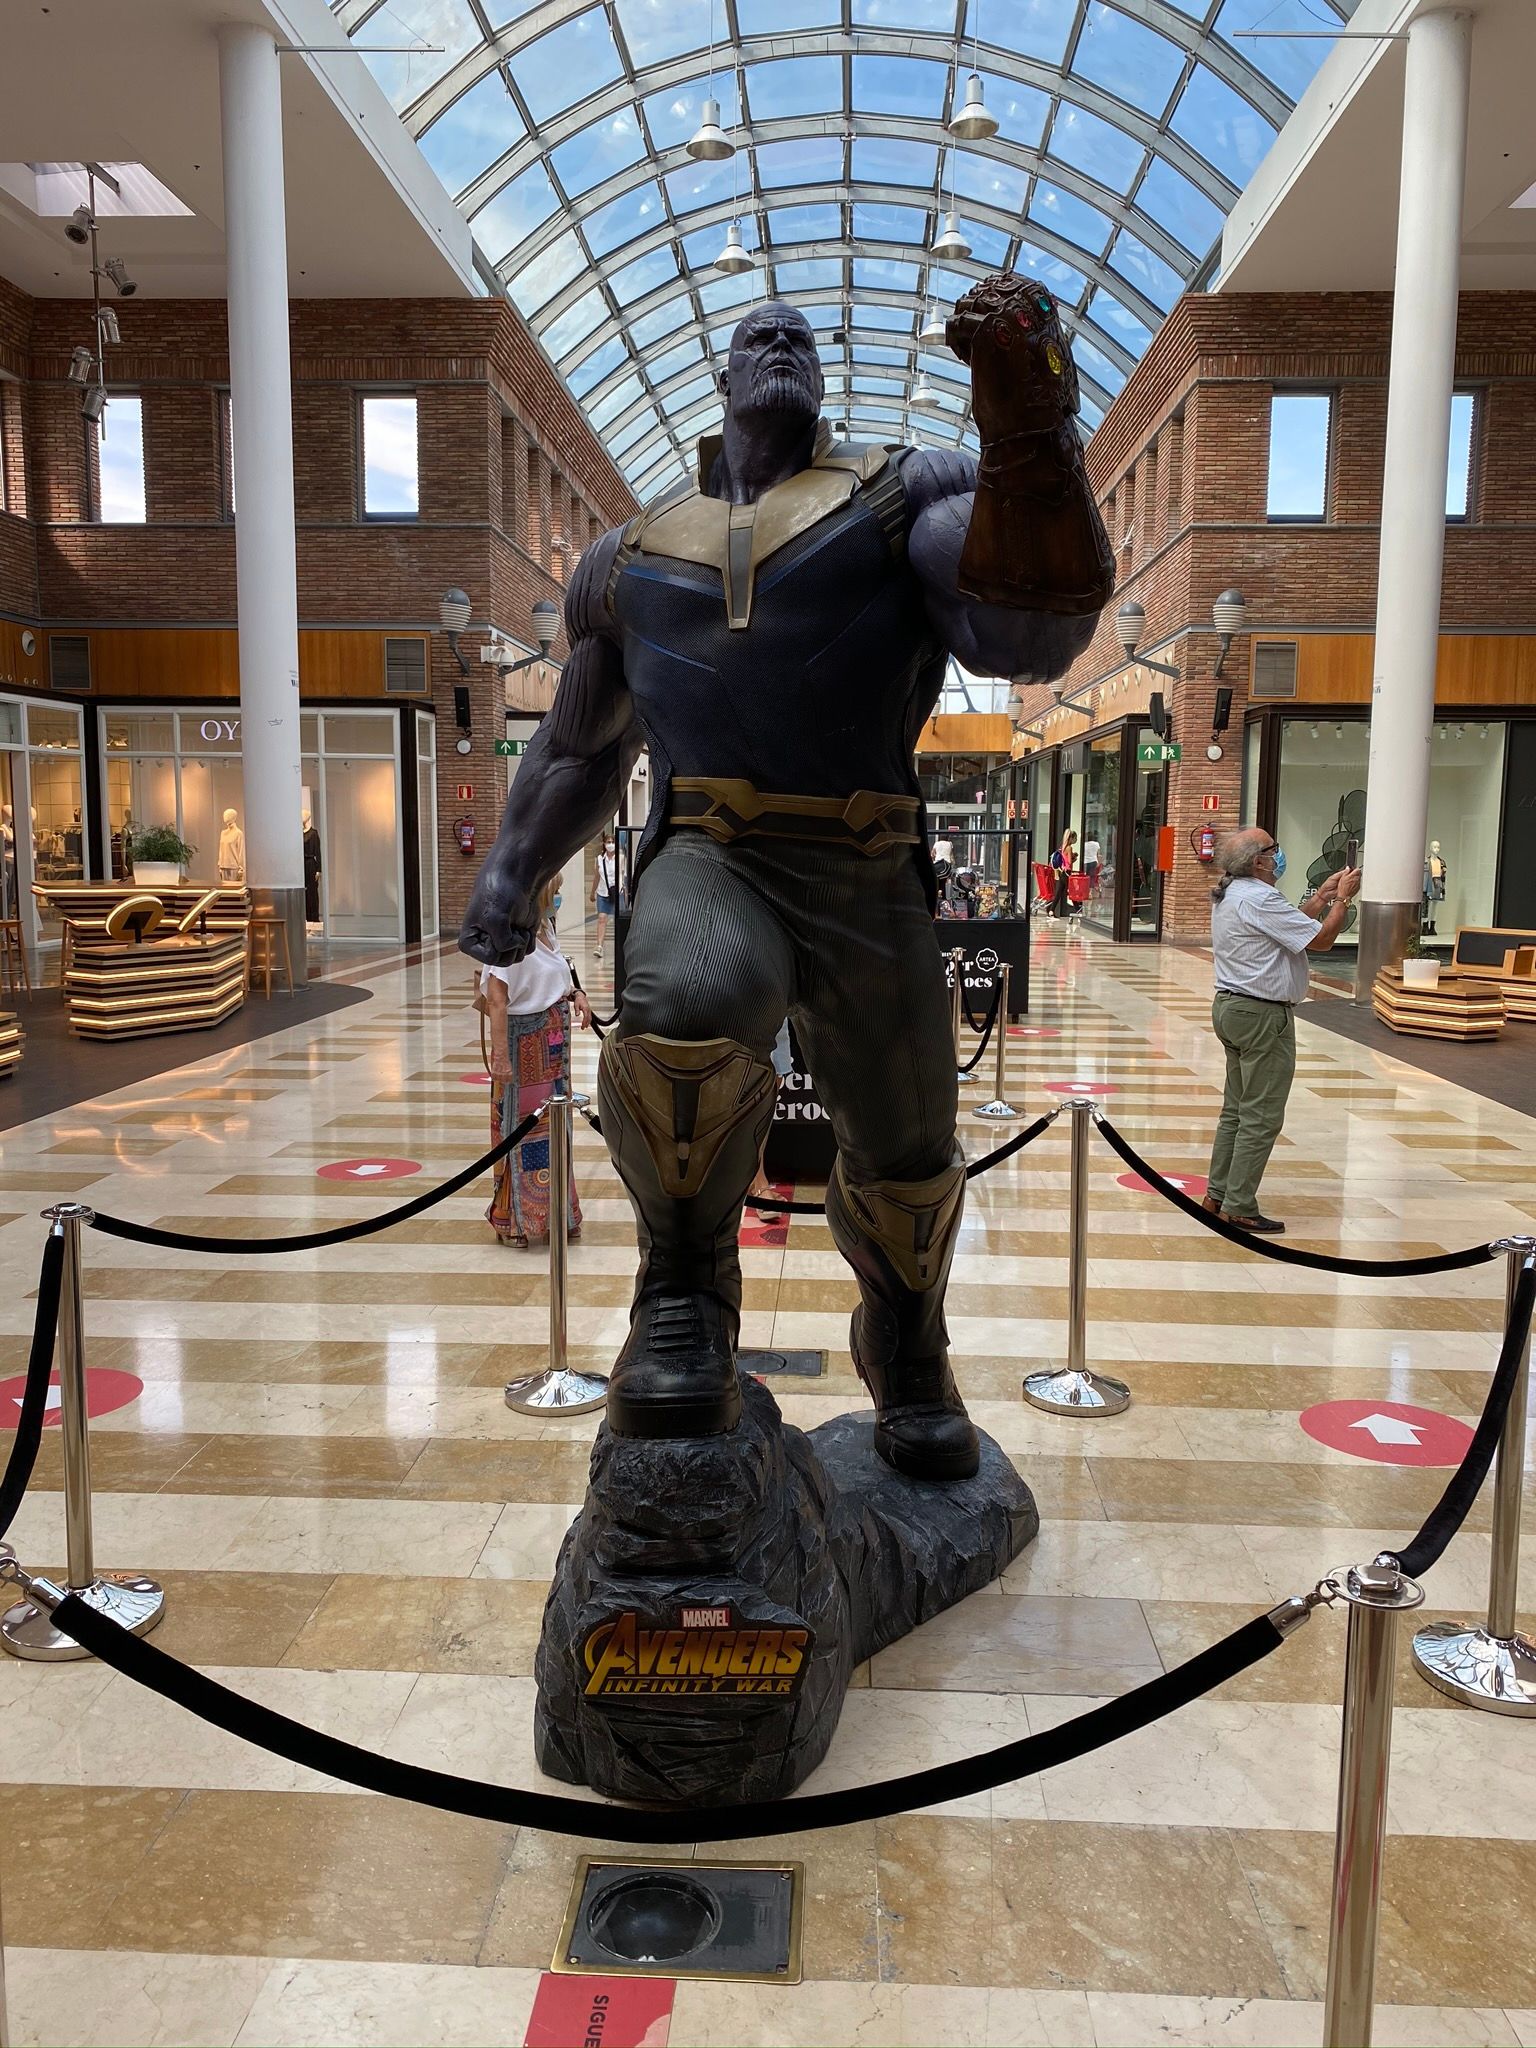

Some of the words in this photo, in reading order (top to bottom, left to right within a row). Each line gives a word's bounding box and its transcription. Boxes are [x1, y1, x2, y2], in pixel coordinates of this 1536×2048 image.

[946, 973, 993, 988] éoes
[682, 1609, 729, 1628] MARVEL
[584, 1612, 809, 1696] AVENGERS
[604, 1679, 727, 1693] INFINITY
[736, 1679, 793, 1693] WAR
